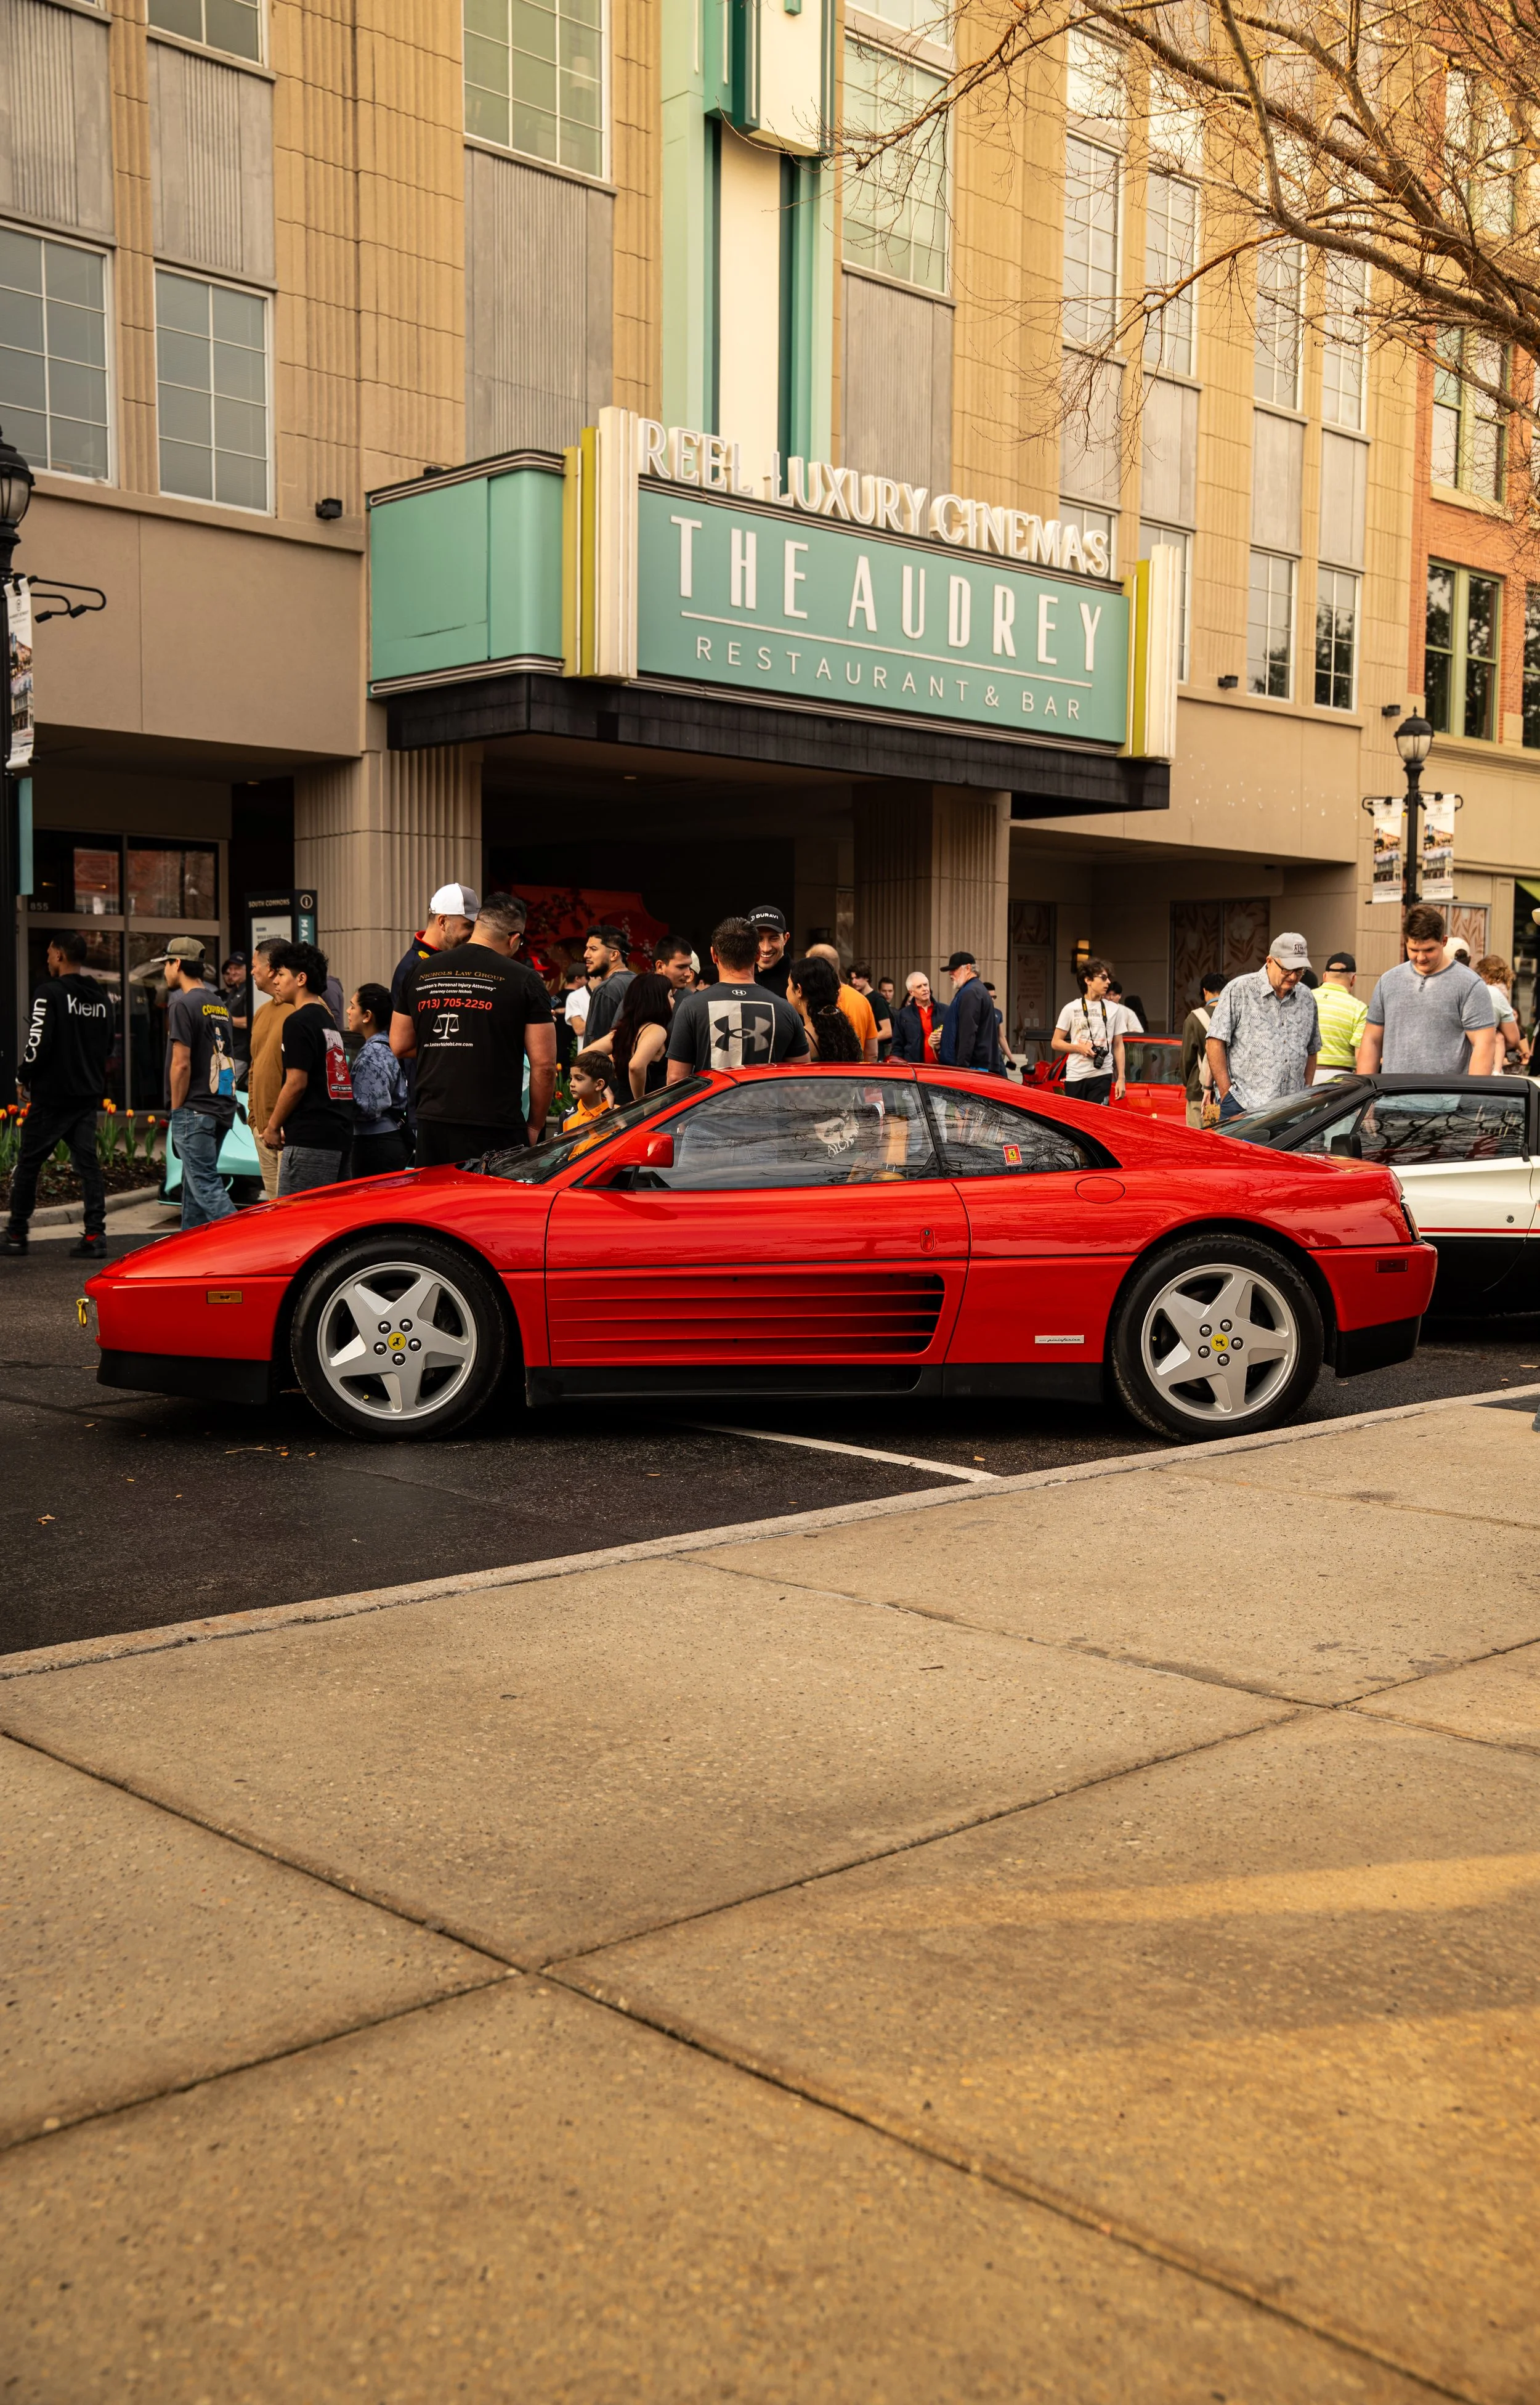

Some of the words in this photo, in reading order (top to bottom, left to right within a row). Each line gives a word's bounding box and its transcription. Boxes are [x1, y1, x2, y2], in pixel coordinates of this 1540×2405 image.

[638, 418, 753, 497] REEL
[763, 450, 928, 536] LUXURY
[929, 494, 1109, 578] CINEMAS
[670, 515, 811, 619] THE
[847, 555, 1102, 672] AUDREY
[697, 635, 970, 702] RESTAURANT
[984, 685, 1000, 707] &
[1021, 691, 1080, 721] BAR
[248, 900, 265, 908] SOUTH
[265, 898, 290, 906] COMMONS
[419, 971, 452, 980] NICHOLS
[474, 971, 505, 982] GROUP
[418, 999, 440, 1012] (713)
[443, 998, 493, 1010] 705-2250
